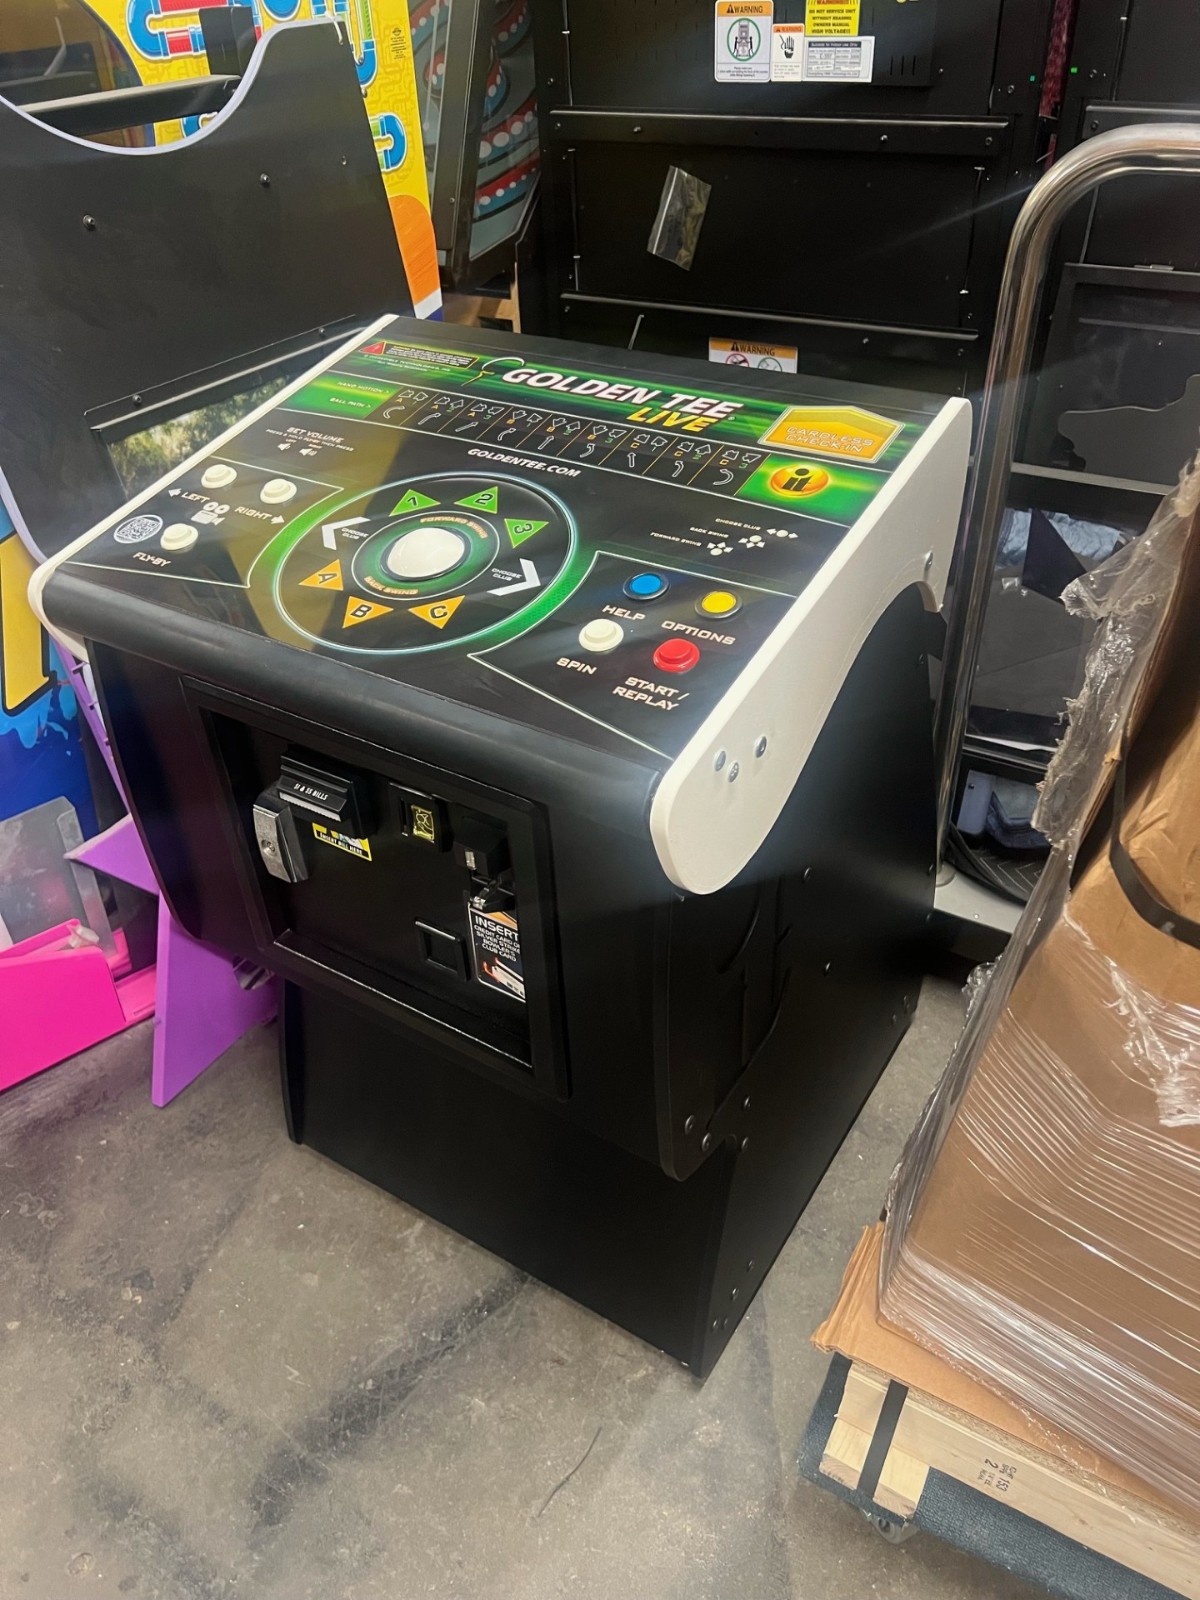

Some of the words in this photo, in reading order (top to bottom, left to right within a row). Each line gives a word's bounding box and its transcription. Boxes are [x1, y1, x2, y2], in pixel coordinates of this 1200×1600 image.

[735, 6, 763, 14] WARNING
[740, 344, 775, 356] WARNING
[502, 368, 660, 405] GOLDEN
[661, 393, 745, 419] TEE
[626, 407, 718, 432] LIVE
[287, 427, 307, 435] SET
[306, 431, 344, 444] VOLUME
[786, 426, 874, 446] CARDLESS
[467, 448, 581, 478] GOLDENTEE.COM
[181, 491, 210, 503] LEFT
[406, 496, 418, 507] 1
[475, 493, 493, 505] 2
[234, 506, 272, 521] RIGHT
[514, 523, 533, 535] 3
[318, 572, 338, 585] A
[350, 604, 373, 618] B
[428, 605, 450, 619] C
[602, 604, 646, 621] HELP
[661, 620, 736, 645] OPTIONS
[556, 657, 597, 675] SPIN
[612, 686, 680, 711] REPLAY
[475, 915, 519, 942] INSERT
[984, 1458, 999, 1469] 2
